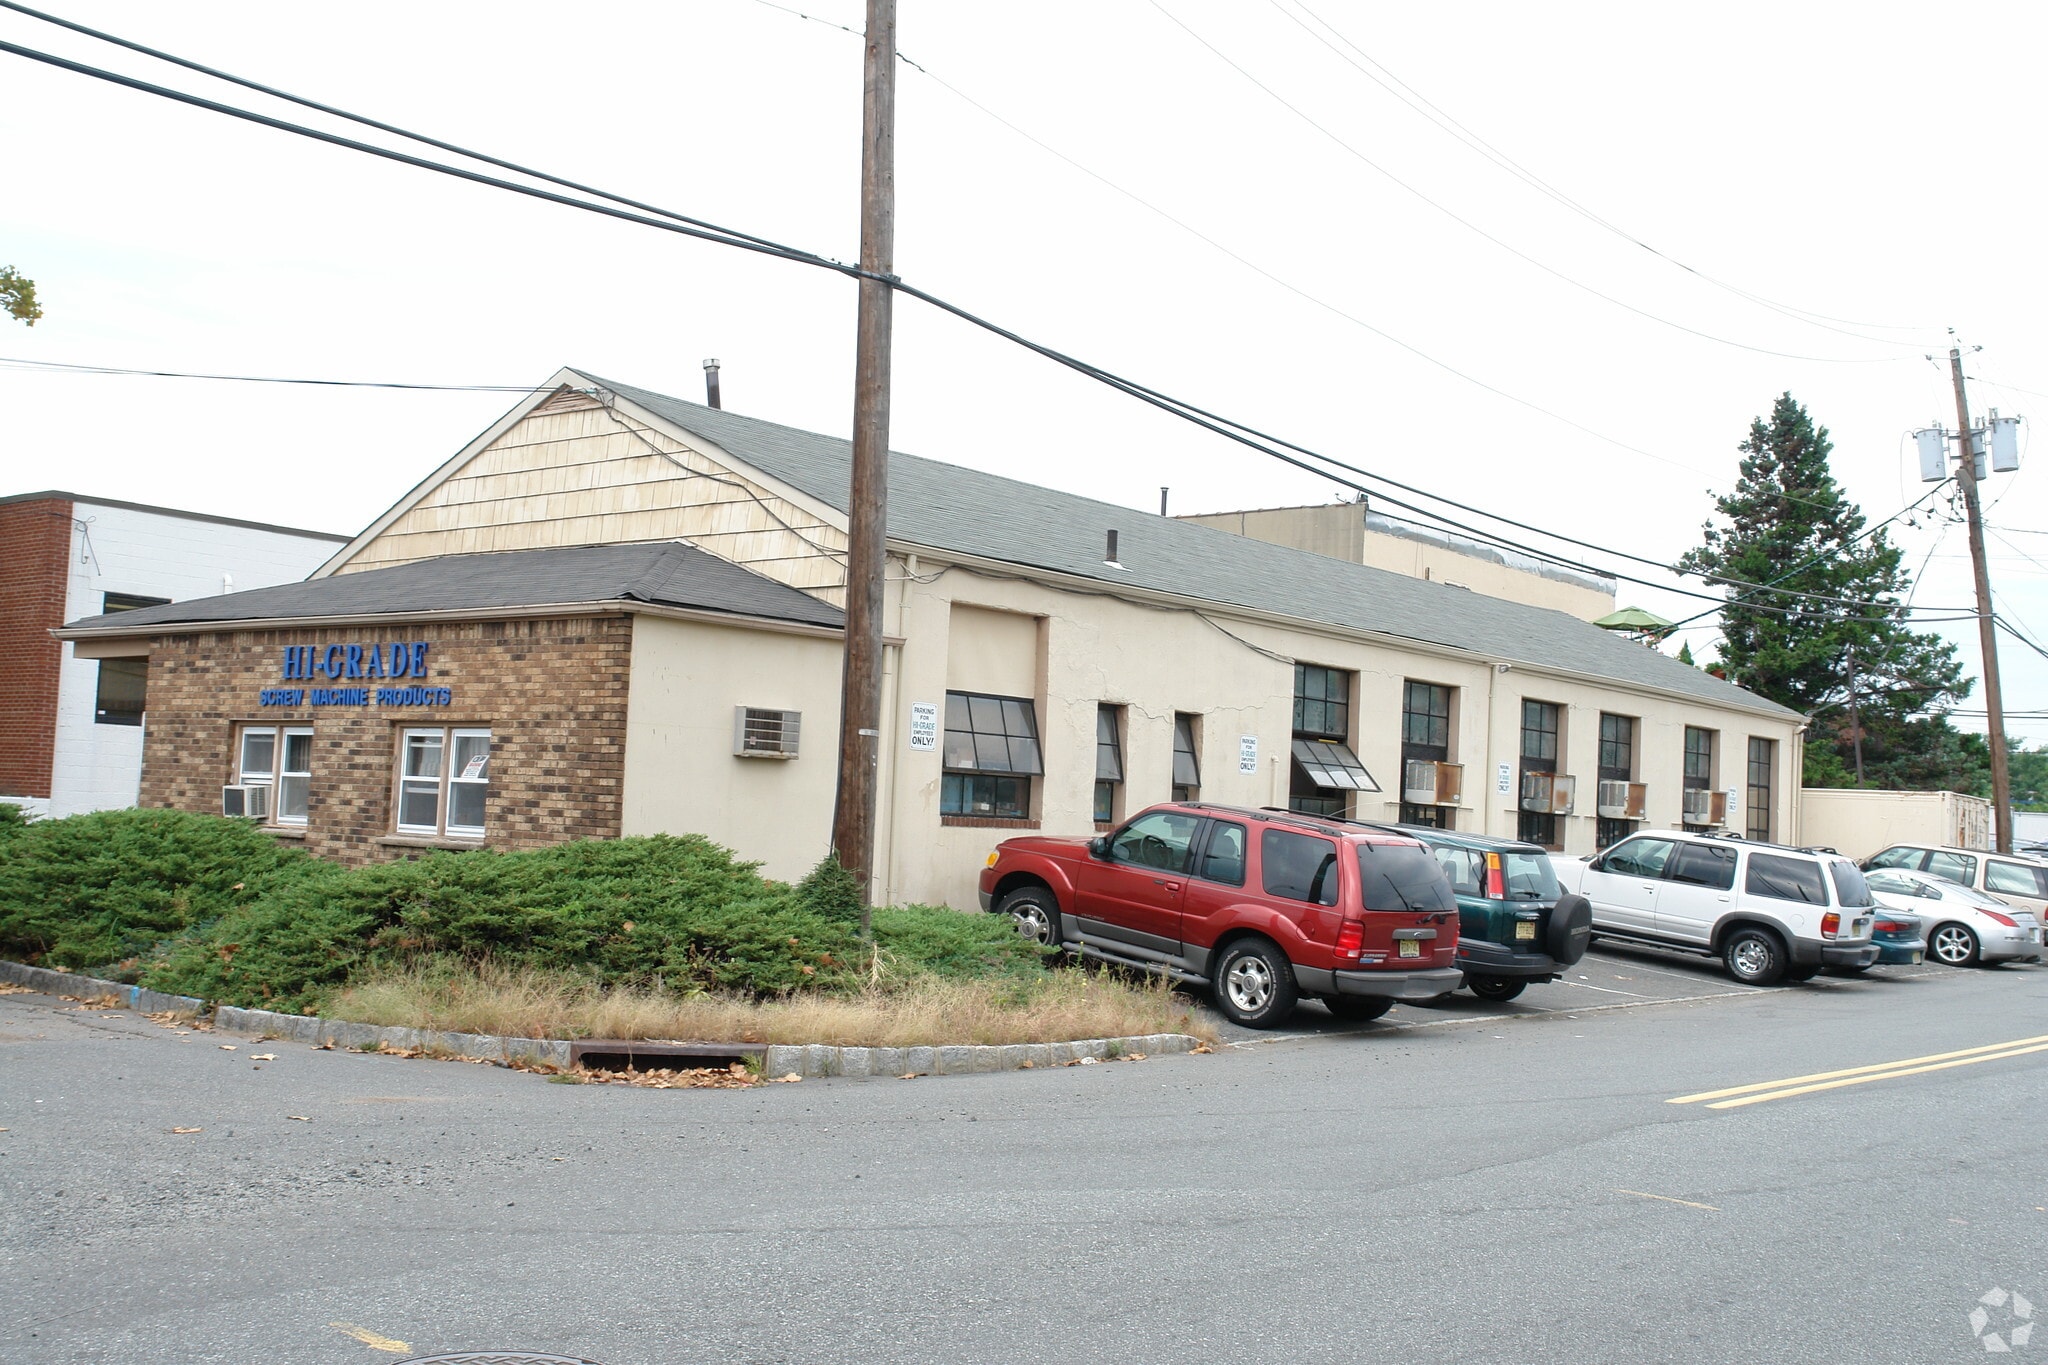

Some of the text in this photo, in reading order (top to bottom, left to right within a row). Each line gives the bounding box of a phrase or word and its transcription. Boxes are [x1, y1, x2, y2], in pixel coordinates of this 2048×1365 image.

[282, 641, 429, 680] HI-GRADE
[259, 686, 452, 707] SCREW MACHINE PRODUCTS
[913, 706, 935, 715] PARKING
[912, 721, 936, 731] HI-GRADE
[911, 735, 935, 747] ONLY!
